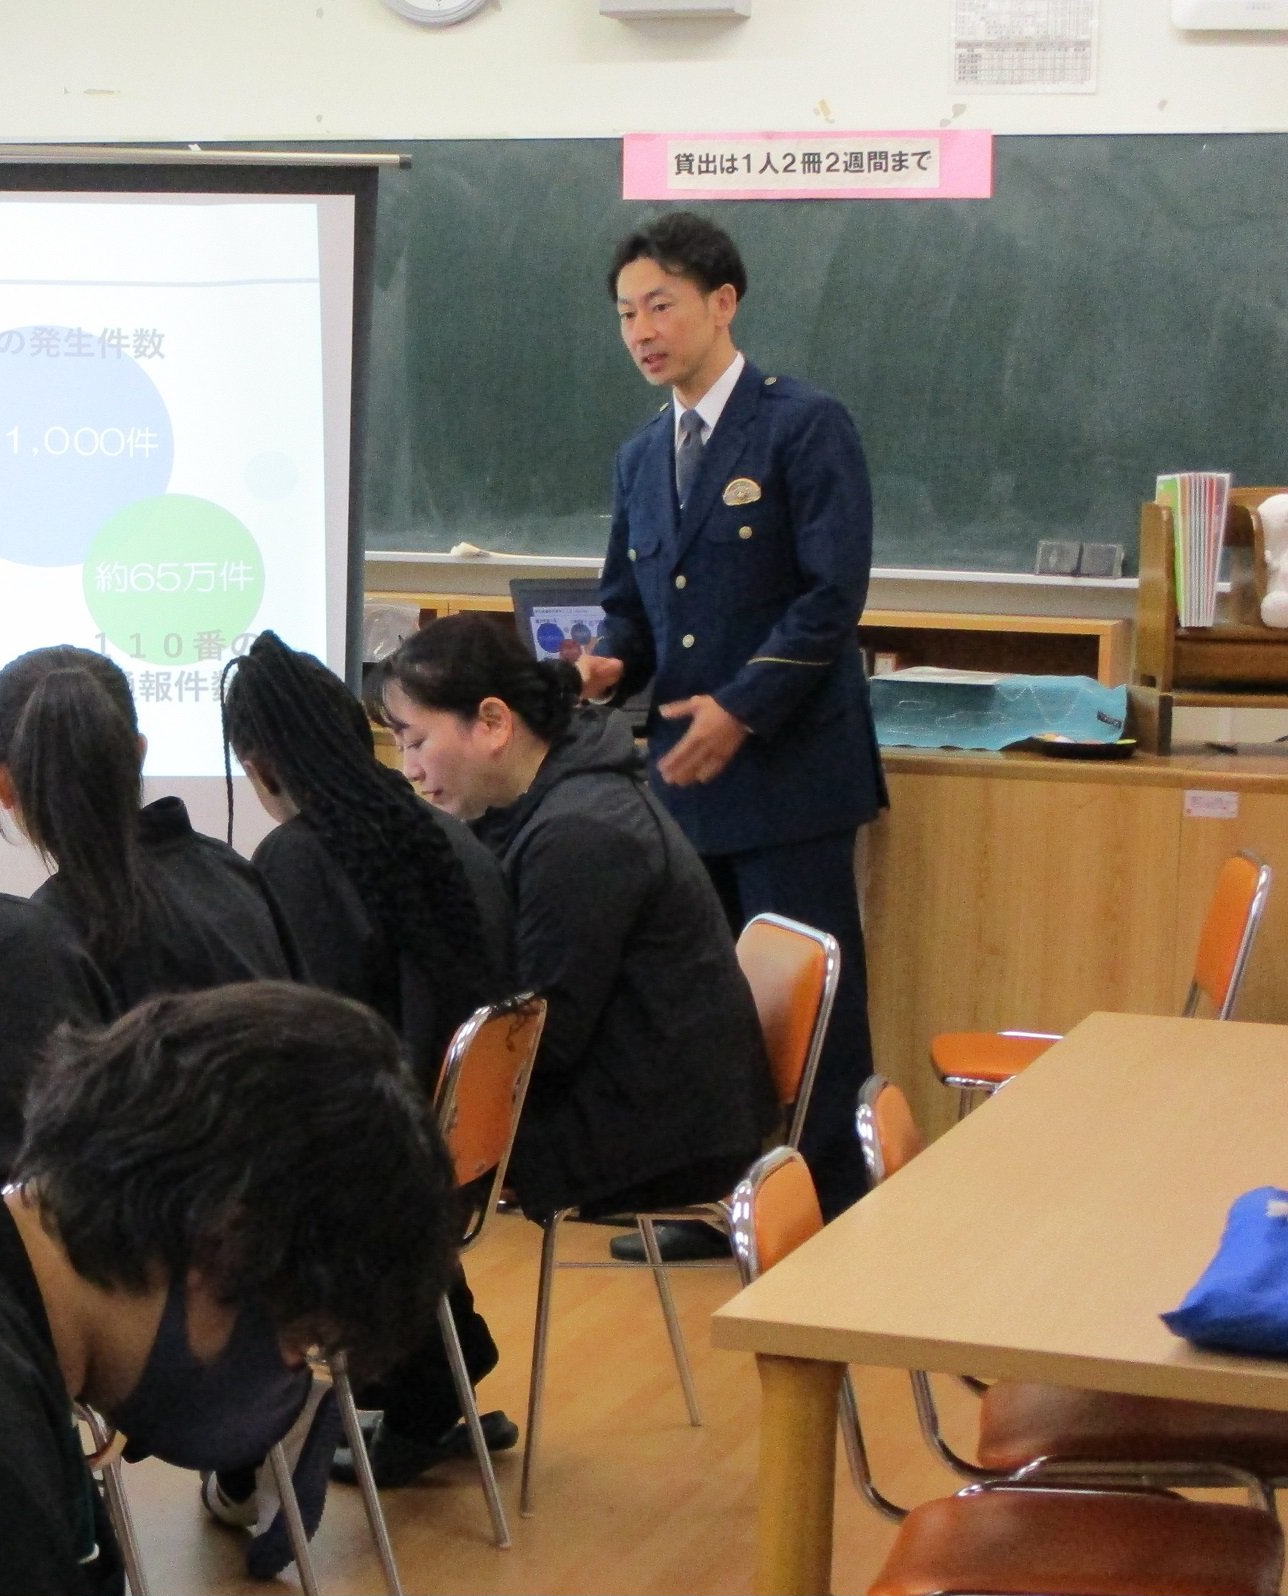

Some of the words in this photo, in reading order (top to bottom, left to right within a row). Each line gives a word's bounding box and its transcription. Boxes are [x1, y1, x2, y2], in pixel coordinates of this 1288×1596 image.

[674, 150, 932, 176] 貸出は1人2冊2週間まで
[95, 560, 255, 594] 約65万件
